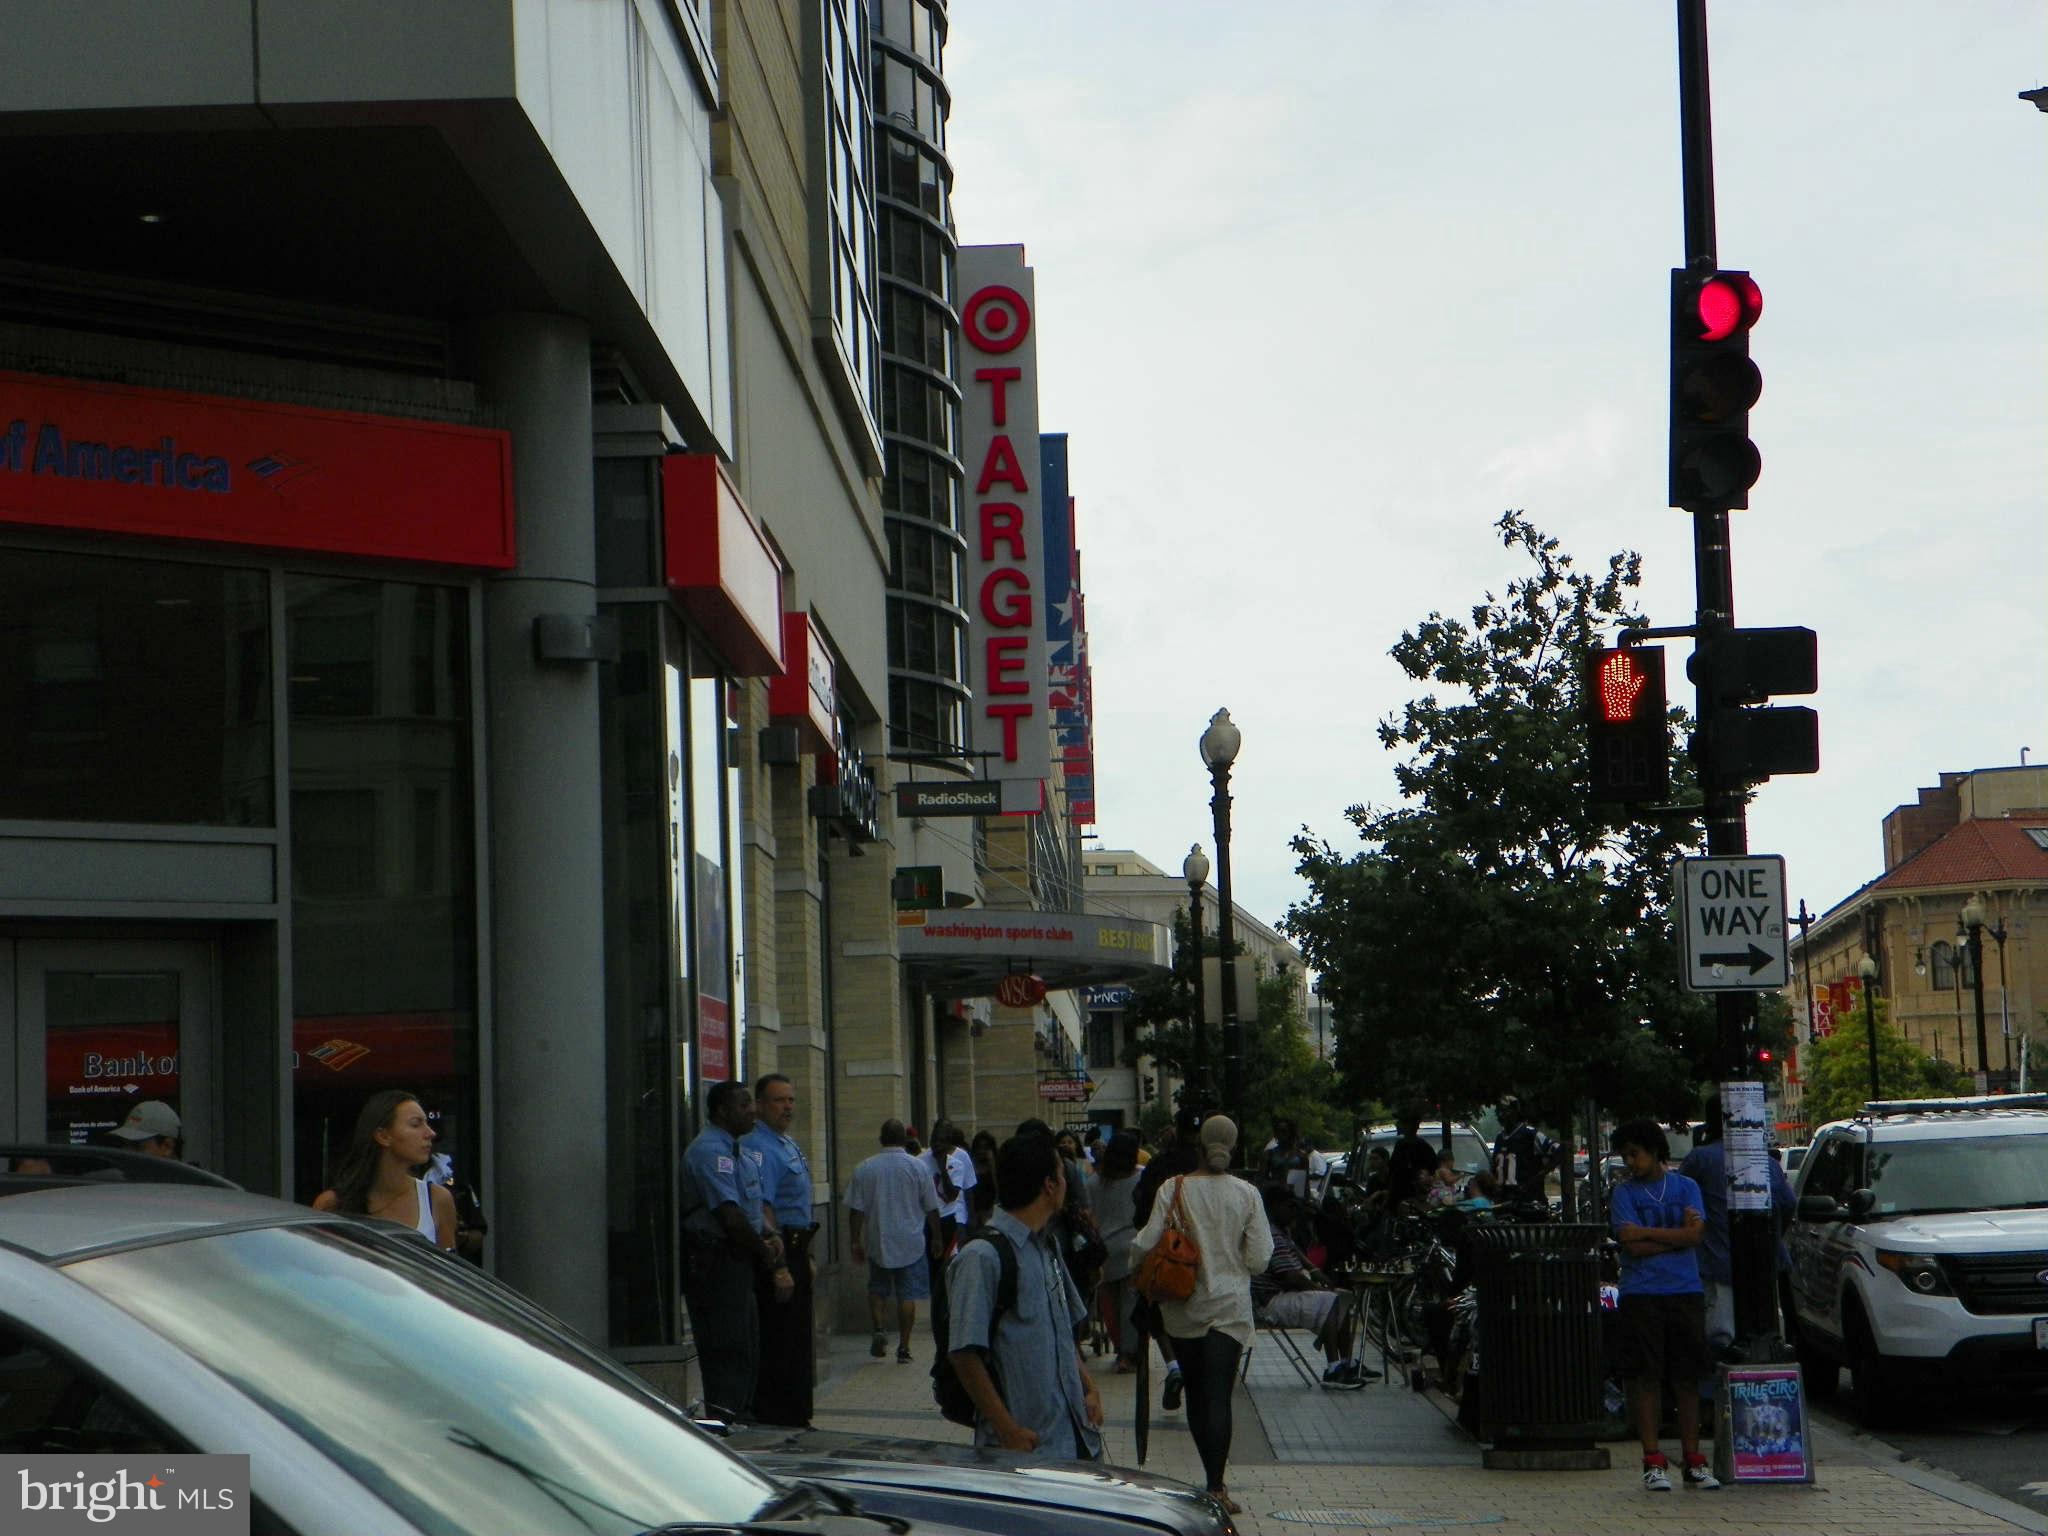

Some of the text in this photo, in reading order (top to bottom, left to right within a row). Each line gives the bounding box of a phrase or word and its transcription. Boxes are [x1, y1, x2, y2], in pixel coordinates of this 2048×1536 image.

[33, 421, 231, 494] America
[975, 367, 1032, 762] TARGET
[917, 792, 997, 806] RadioShack
[1701, 869, 1768, 899] ONE
[924, 923, 1073, 941] washington sports clubs
[1700, 906, 1769, 936] WAY
[1098, 927, 1132, 949] BEST
[84, 1050, 153, 1078] Bank
